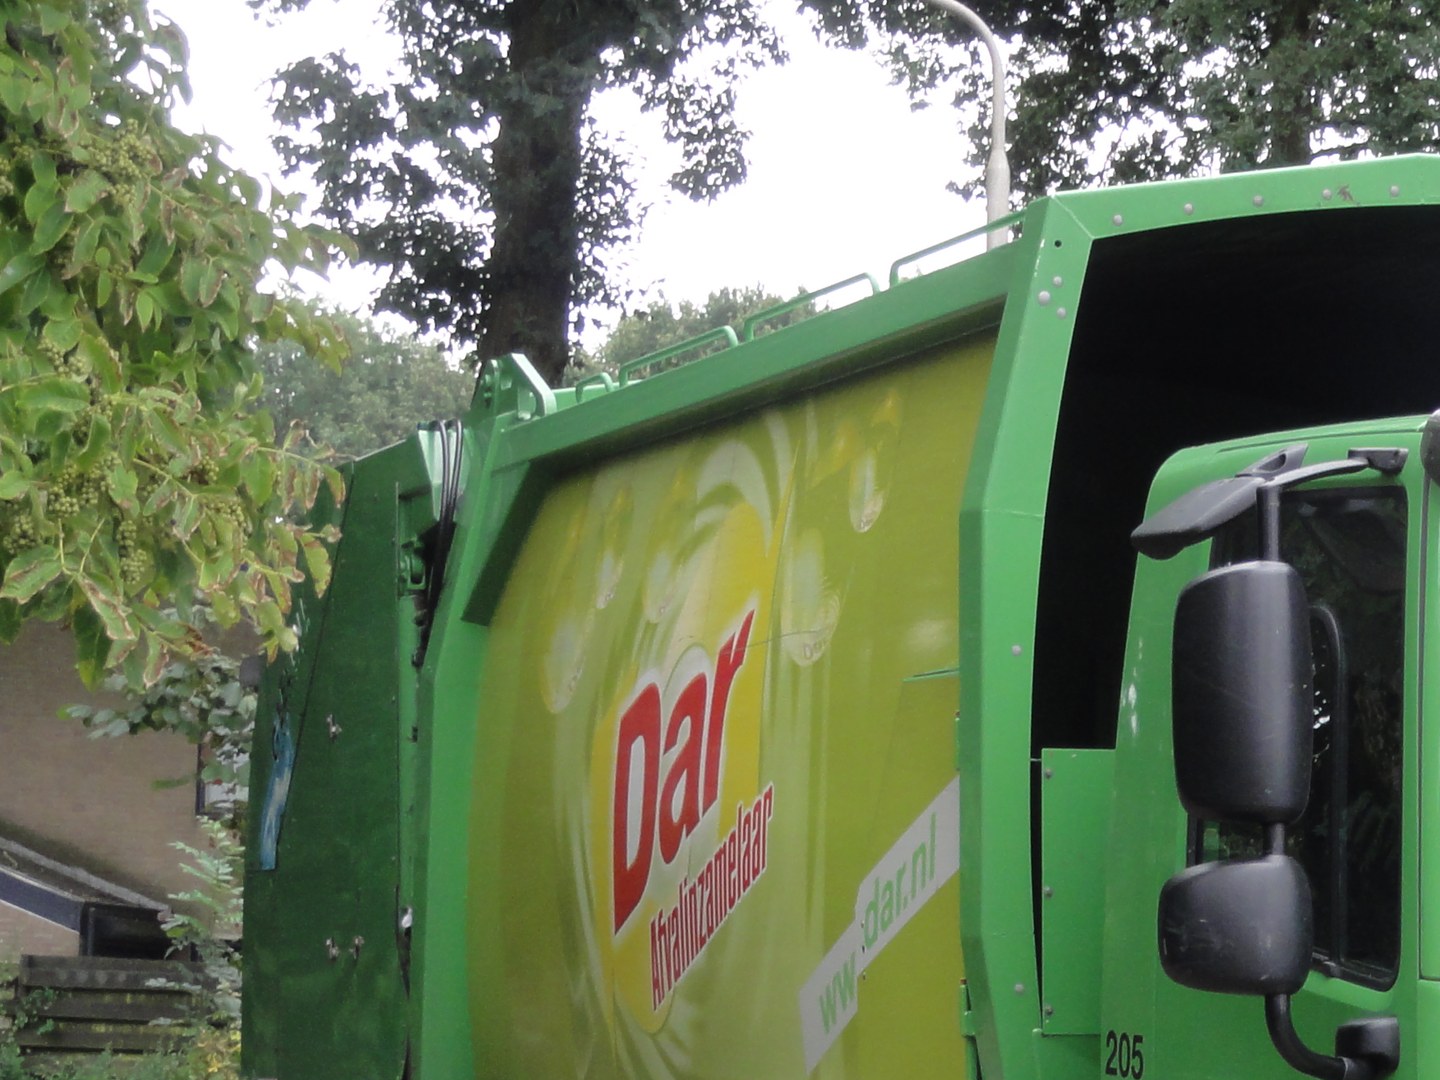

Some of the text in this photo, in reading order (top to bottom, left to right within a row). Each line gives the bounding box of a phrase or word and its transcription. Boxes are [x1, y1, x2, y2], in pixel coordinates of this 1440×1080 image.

[613, 608, 755, 935] Dar
[651, 783, 773, 1012] Afvalinzamelaar
[1105, 1030, 1145, 1080] 205
